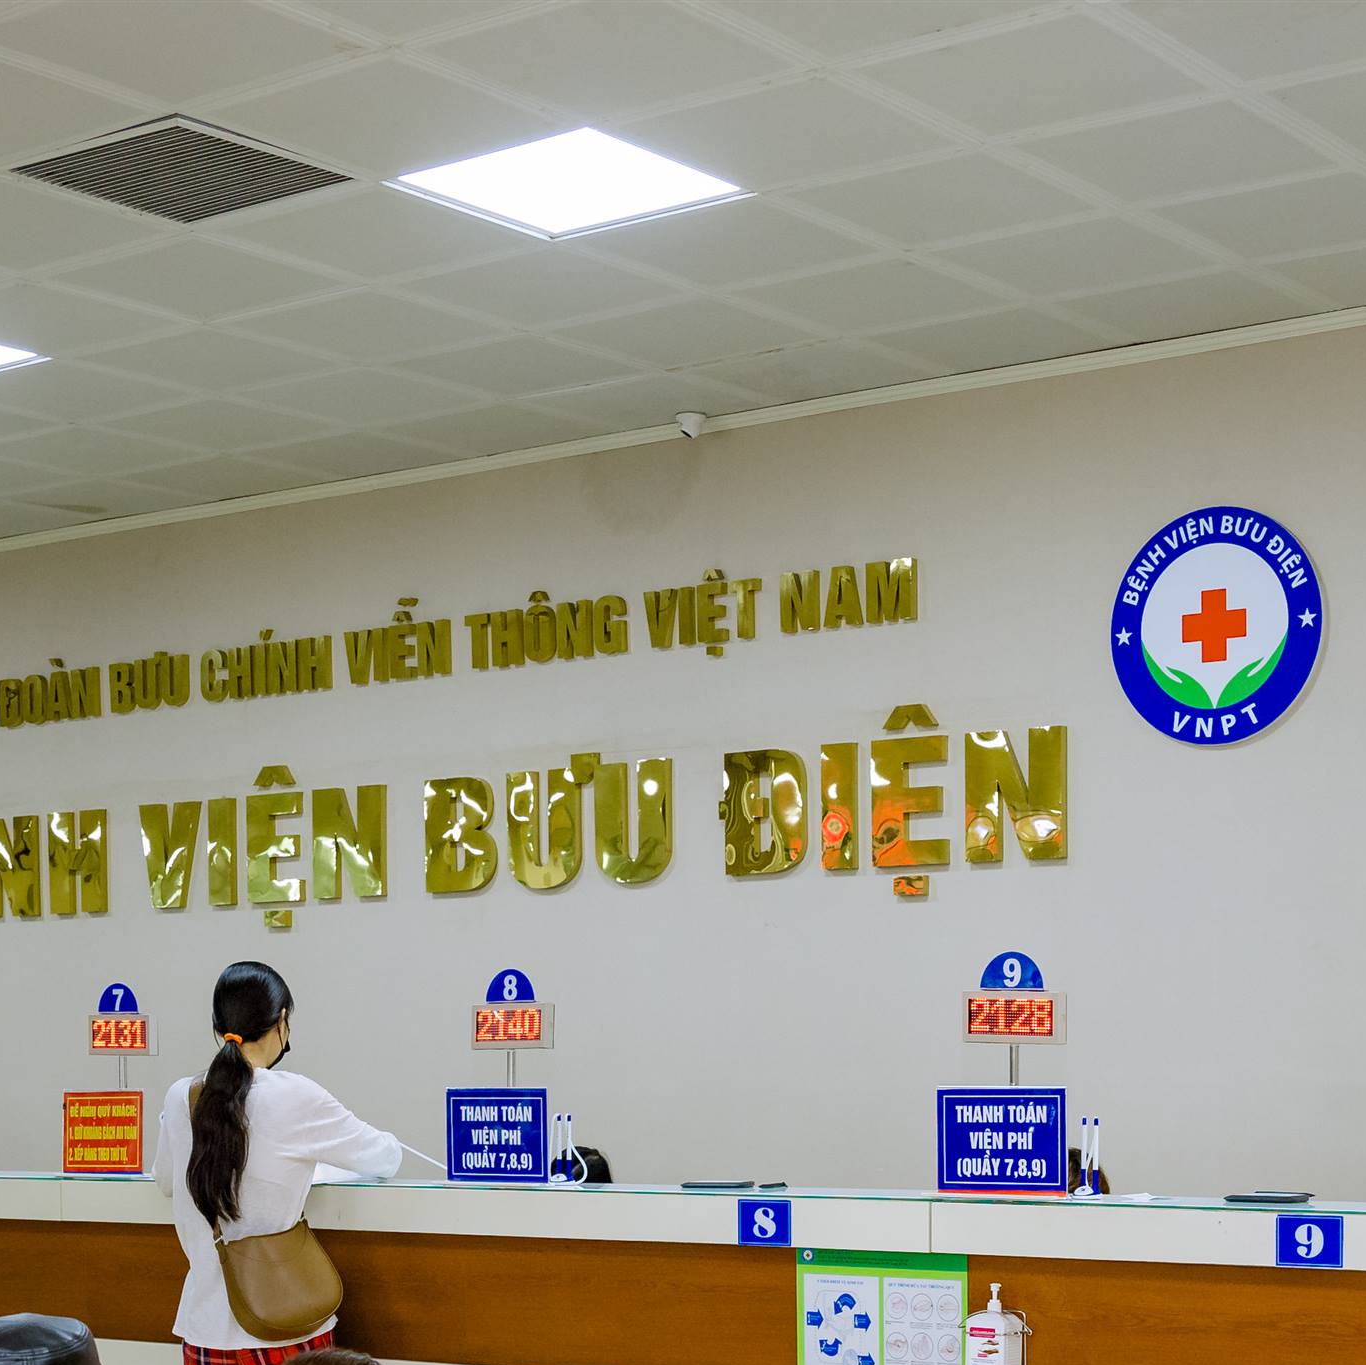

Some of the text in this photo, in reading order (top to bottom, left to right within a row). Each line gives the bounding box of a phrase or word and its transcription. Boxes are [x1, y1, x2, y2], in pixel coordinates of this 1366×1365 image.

[1122, 515, 1308, 606] BỆNH VIỆN BƯU ĐIỆN
[109, 651, 190, 714] BƯU
[200, 629, 333, 703] CHÍNH
[343, 597, 451, 688] VIỄN
[464, 591, 628, 670] THÔNG
[643, 568, 762, 657] VIỆT
[779, 557, 918, 634] NAM
[1172, 703, 1259, 738] VNPT
[139, 765, 388, 929] VIỆN
[424, 752, 673, 894] BƯU
[718, 703, 1068, 897] ĐIỆN
[1002, 958, 1022, 988] 9
[112, 989, 124, 1011] 7
[503, 975, 518, 1001] 8
[476, 1008, 541, 1041] 2140
[970, 998, 1052, 1034] 2128
[92, 1020, 145, 1047] 2131
[460, 1103, 533, 1122] THANH TOÁN
[955, 1101, 1047, 1124] THANH TOÁN
[471, 1126, 522, 1147] VIỆN PHÍ
[969, 1126, 1035, 1152] VIỆN PHÍ
[499, 1152, 533, 1171] 7,8,9)
[1004, 1158, 1047, 1179] 7,8,9)
[752, 1207, 777, 1238] 8
[1294, 1224, 1325, 1258] 9
